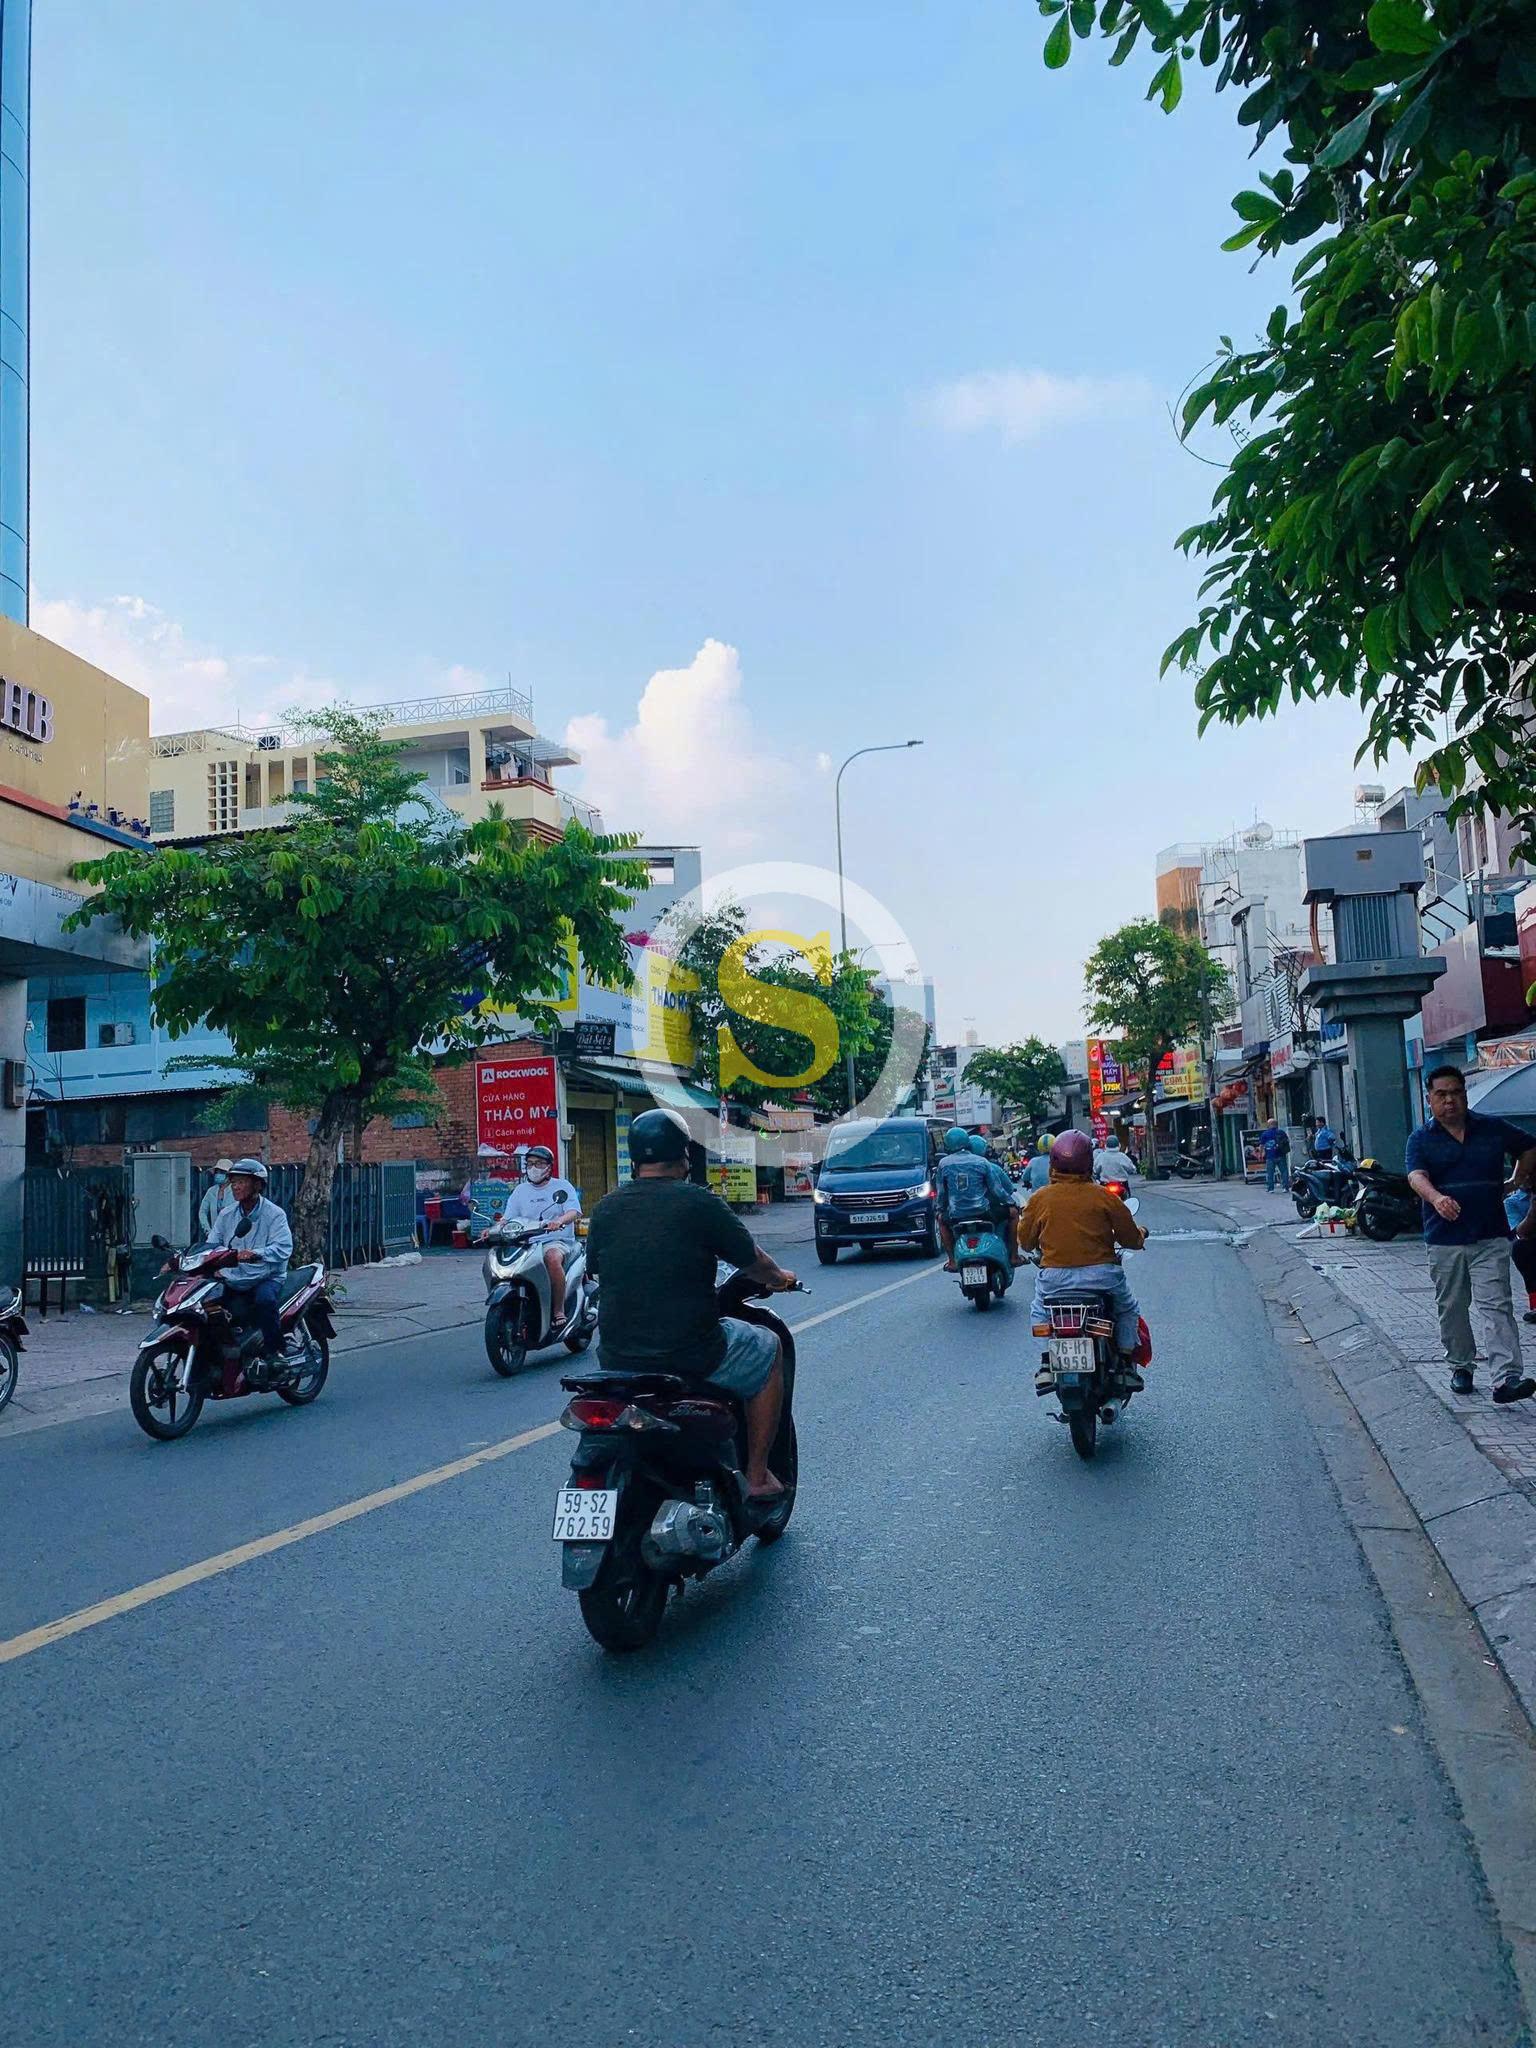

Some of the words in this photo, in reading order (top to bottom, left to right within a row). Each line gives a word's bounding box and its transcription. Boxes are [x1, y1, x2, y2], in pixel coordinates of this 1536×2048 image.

[580, 1024, 609, 1033] SPA
[496, 1067, 549, 1079] ROCKWOOL
[482, 1093, 500, 1103] CỬA
[502, 1092, 526, 1101] HÀNG
[484, 1106, 524, 1122] THẢO
[530, 1106, 550, 1119] MY
[495, 1129, 514, 1138] Cách
[516, 1127, 536, 1137] nhiệt
[1056, 1356, 1088, 1369] 1959
[555, 1516, 611, 1538] 762.59
